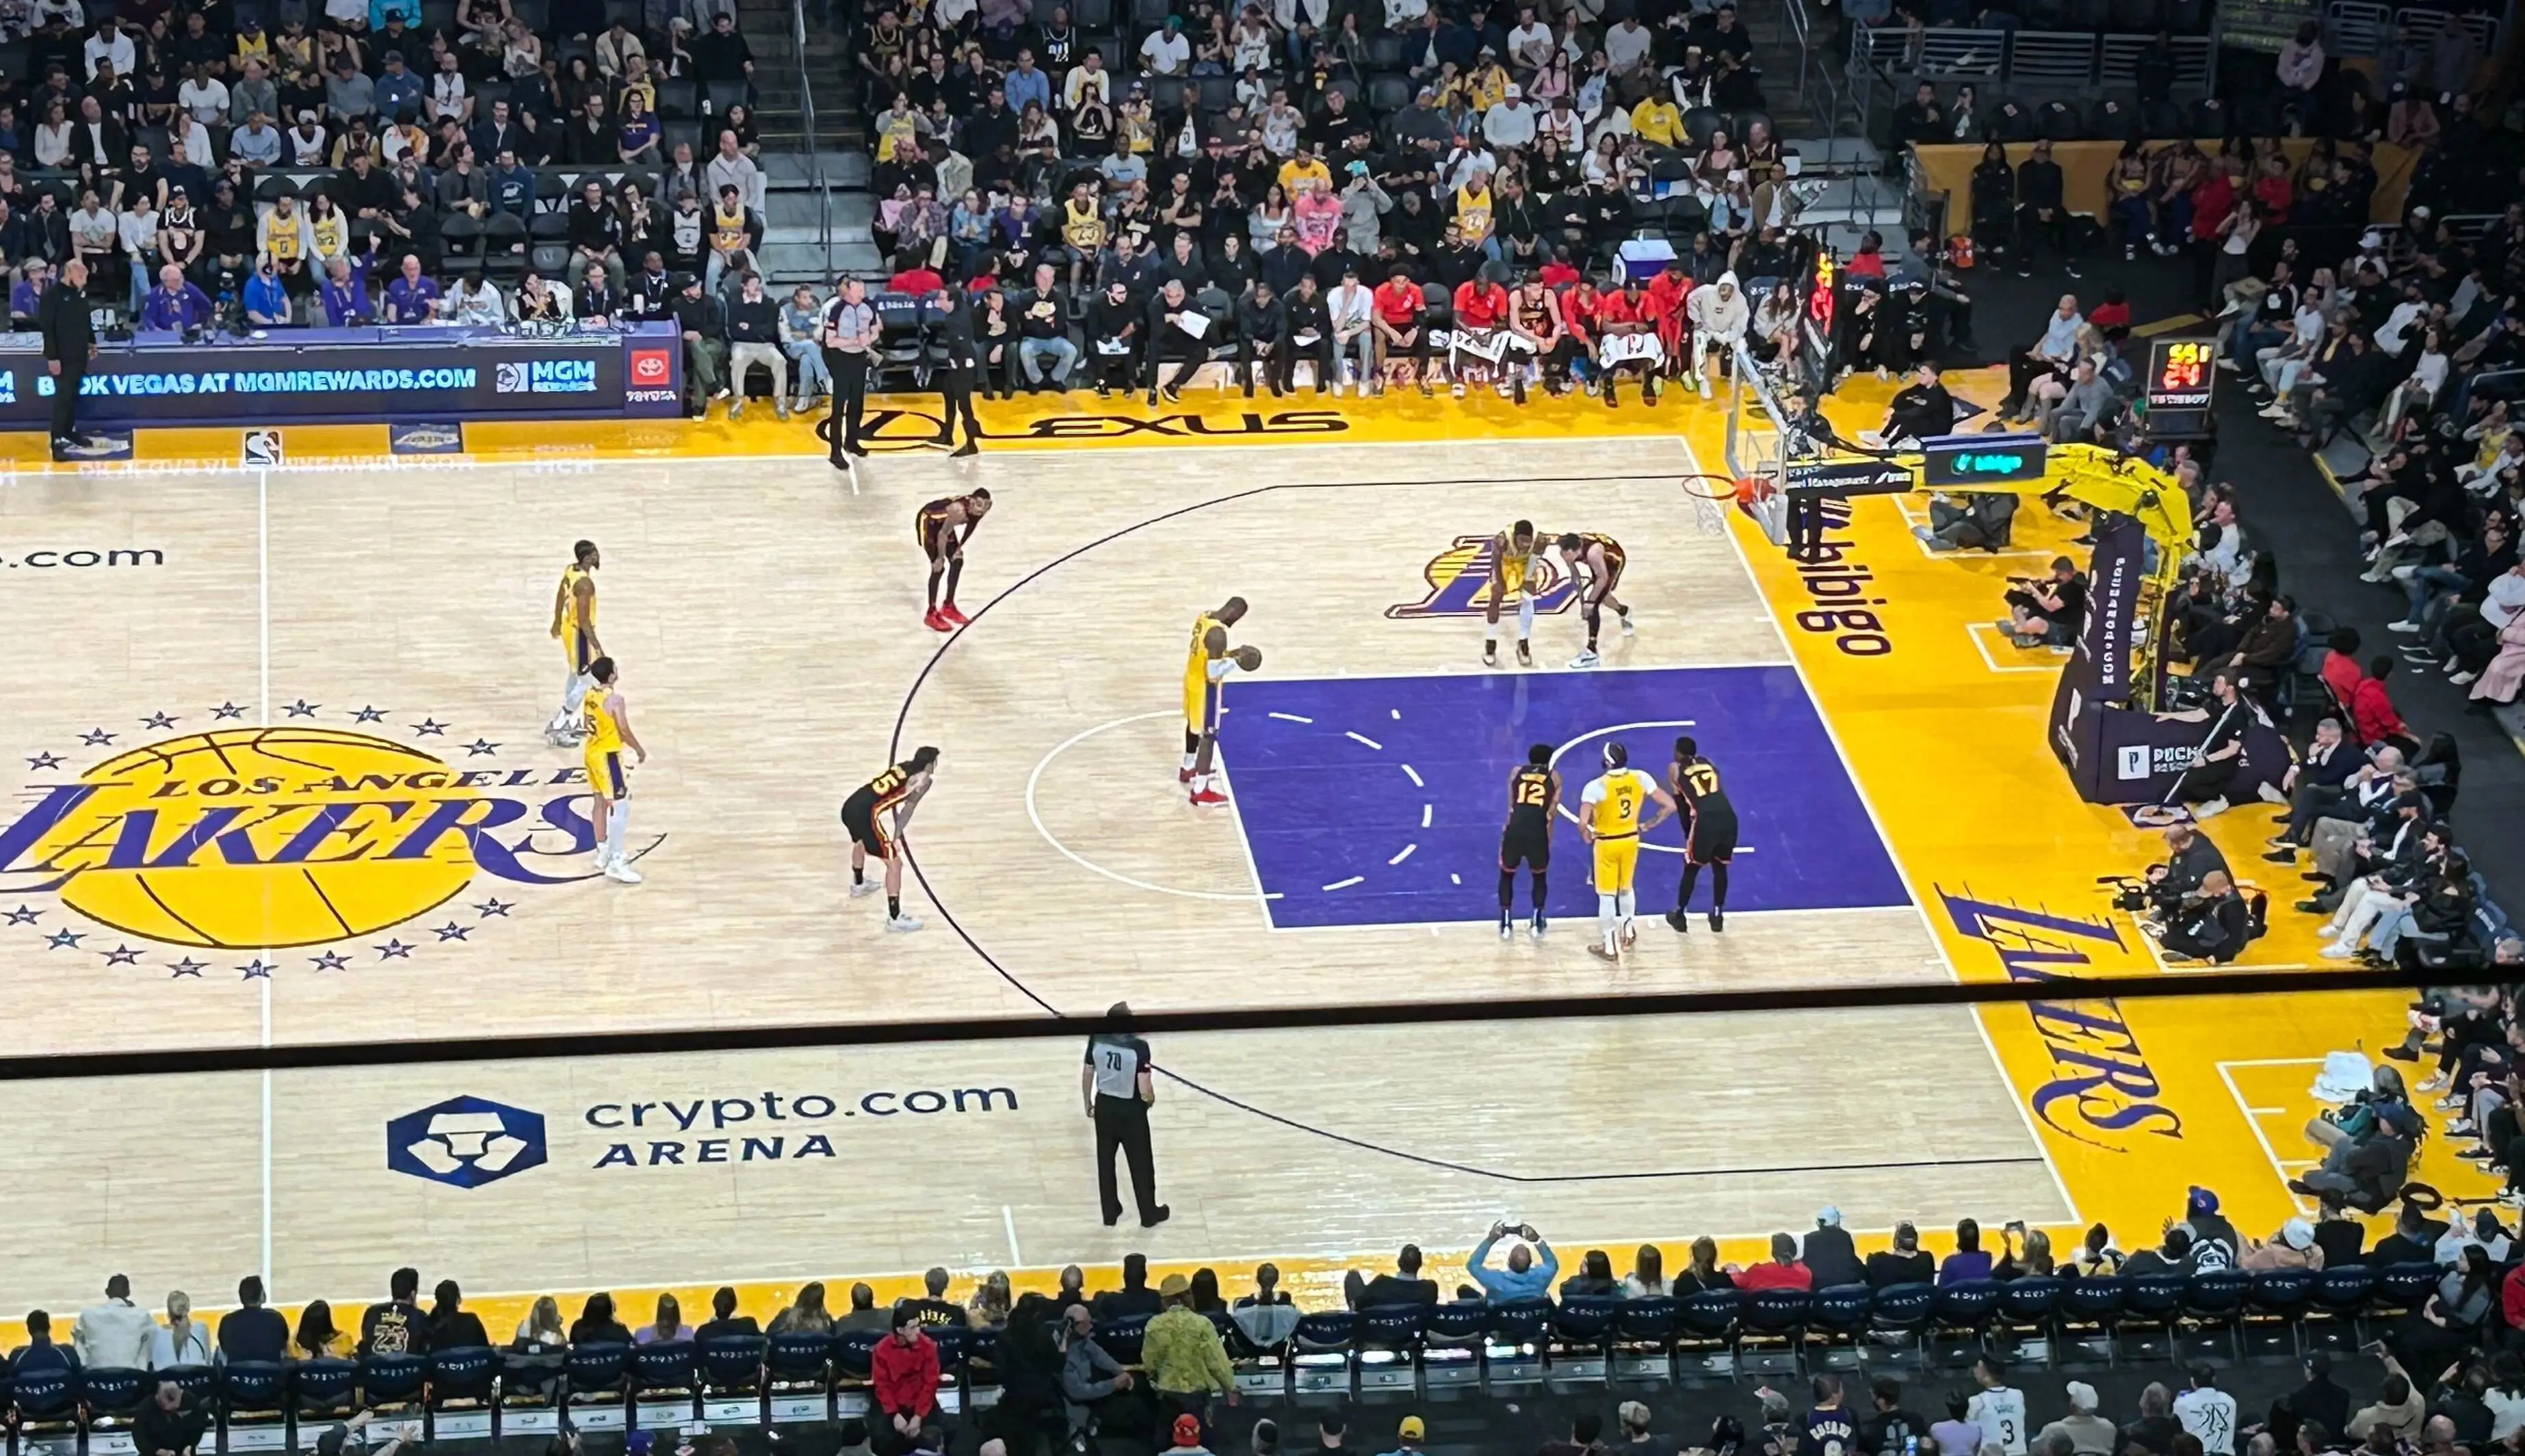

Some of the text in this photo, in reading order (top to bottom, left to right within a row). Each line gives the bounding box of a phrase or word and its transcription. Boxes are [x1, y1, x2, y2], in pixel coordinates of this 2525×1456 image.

[38, 375, 109, 396] BOK
[111, 373, 195, 395] VEGAS
[198, 372, 231, 393] AT
[235, 367, 476, 392] MGMREWARDS.COM
[532, 360, 595, 380] MGM
[0, 549, 163, 568] .com
[148, 767, 633, 798] LOS ANGELE
[1517, 781, 1546, 807] 12
[1690, 771, 1718, 797] 17
[1619, 799, 1632, 819] 3
[0, 784, 667, 892] LAKERS
[1106, 1050, 1122, 1072] 70
[585, 1087, 1019, 1131] crypto.com
[592, 1135, 837, 1169] ARENA
[2000, 1419, 2015, 1445] 3
